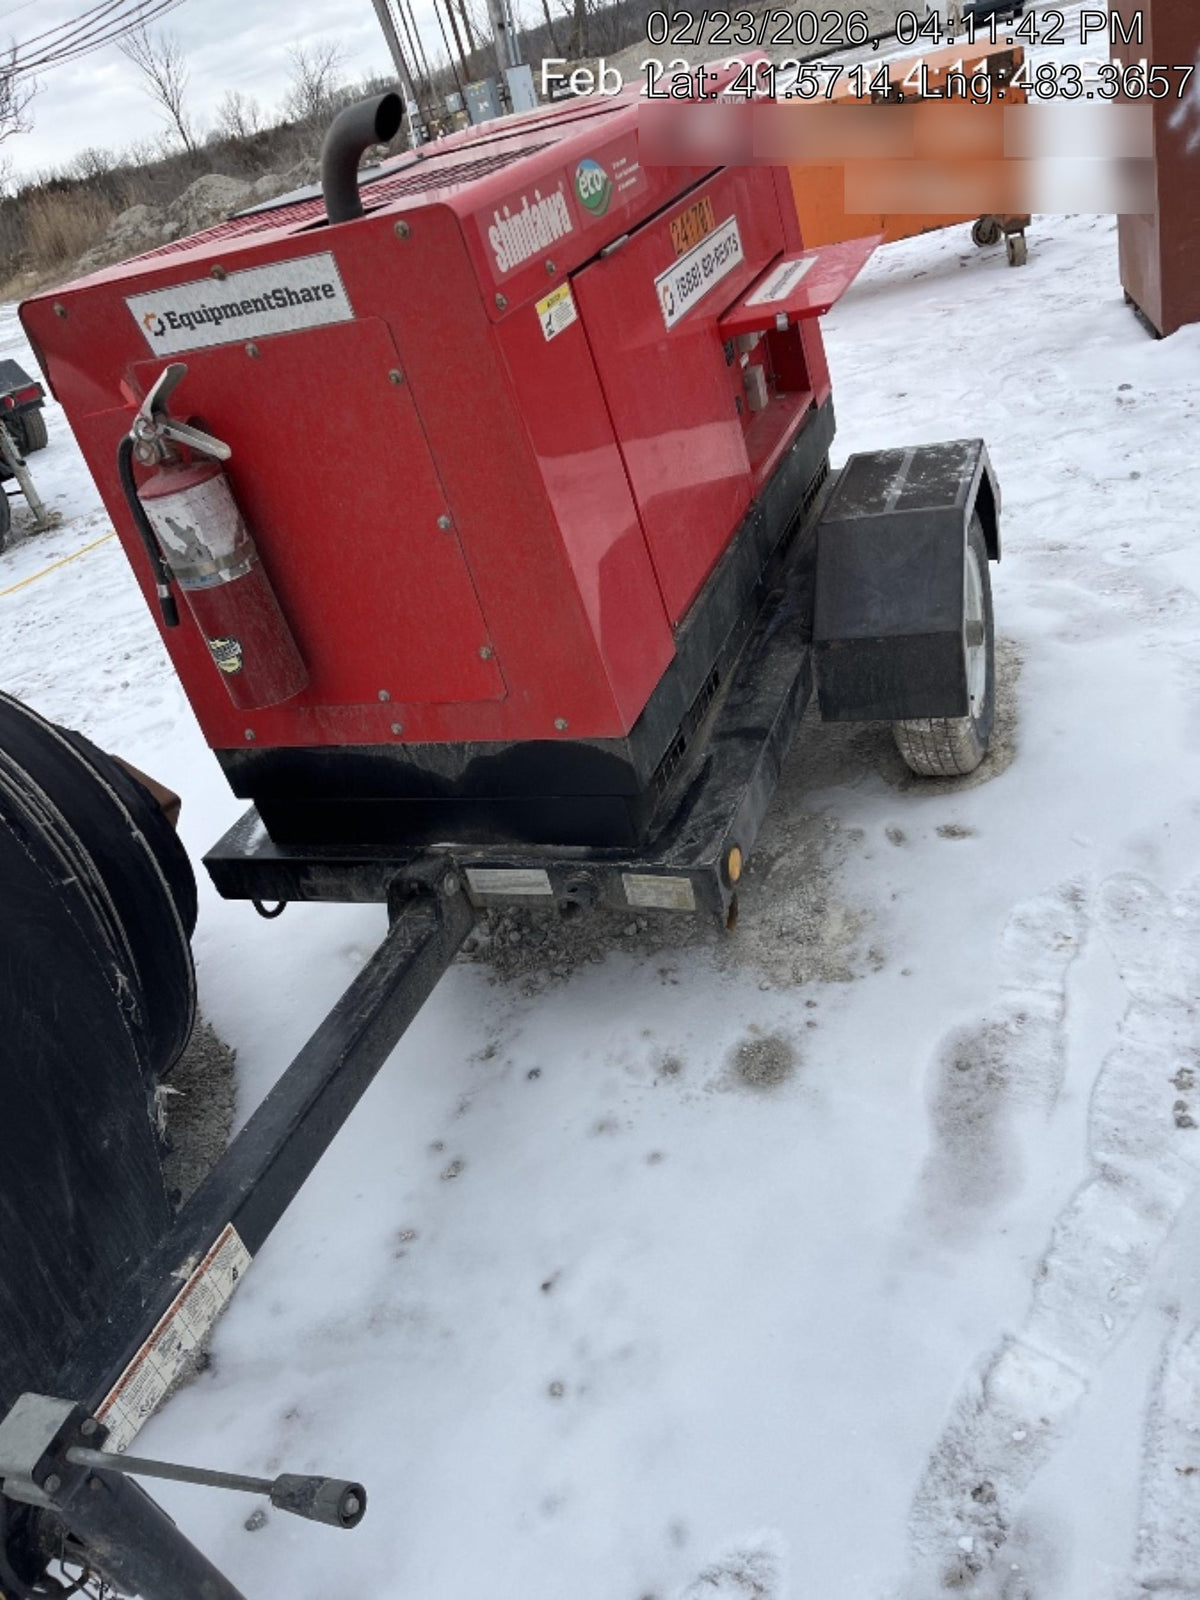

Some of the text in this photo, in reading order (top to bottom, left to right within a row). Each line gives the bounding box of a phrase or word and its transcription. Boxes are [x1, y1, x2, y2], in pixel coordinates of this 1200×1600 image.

[579, 168, 602, 199] eco
[489, 185, 573, 273] shindaiwa
[165, 280, 335, 331] EquipmentShare
